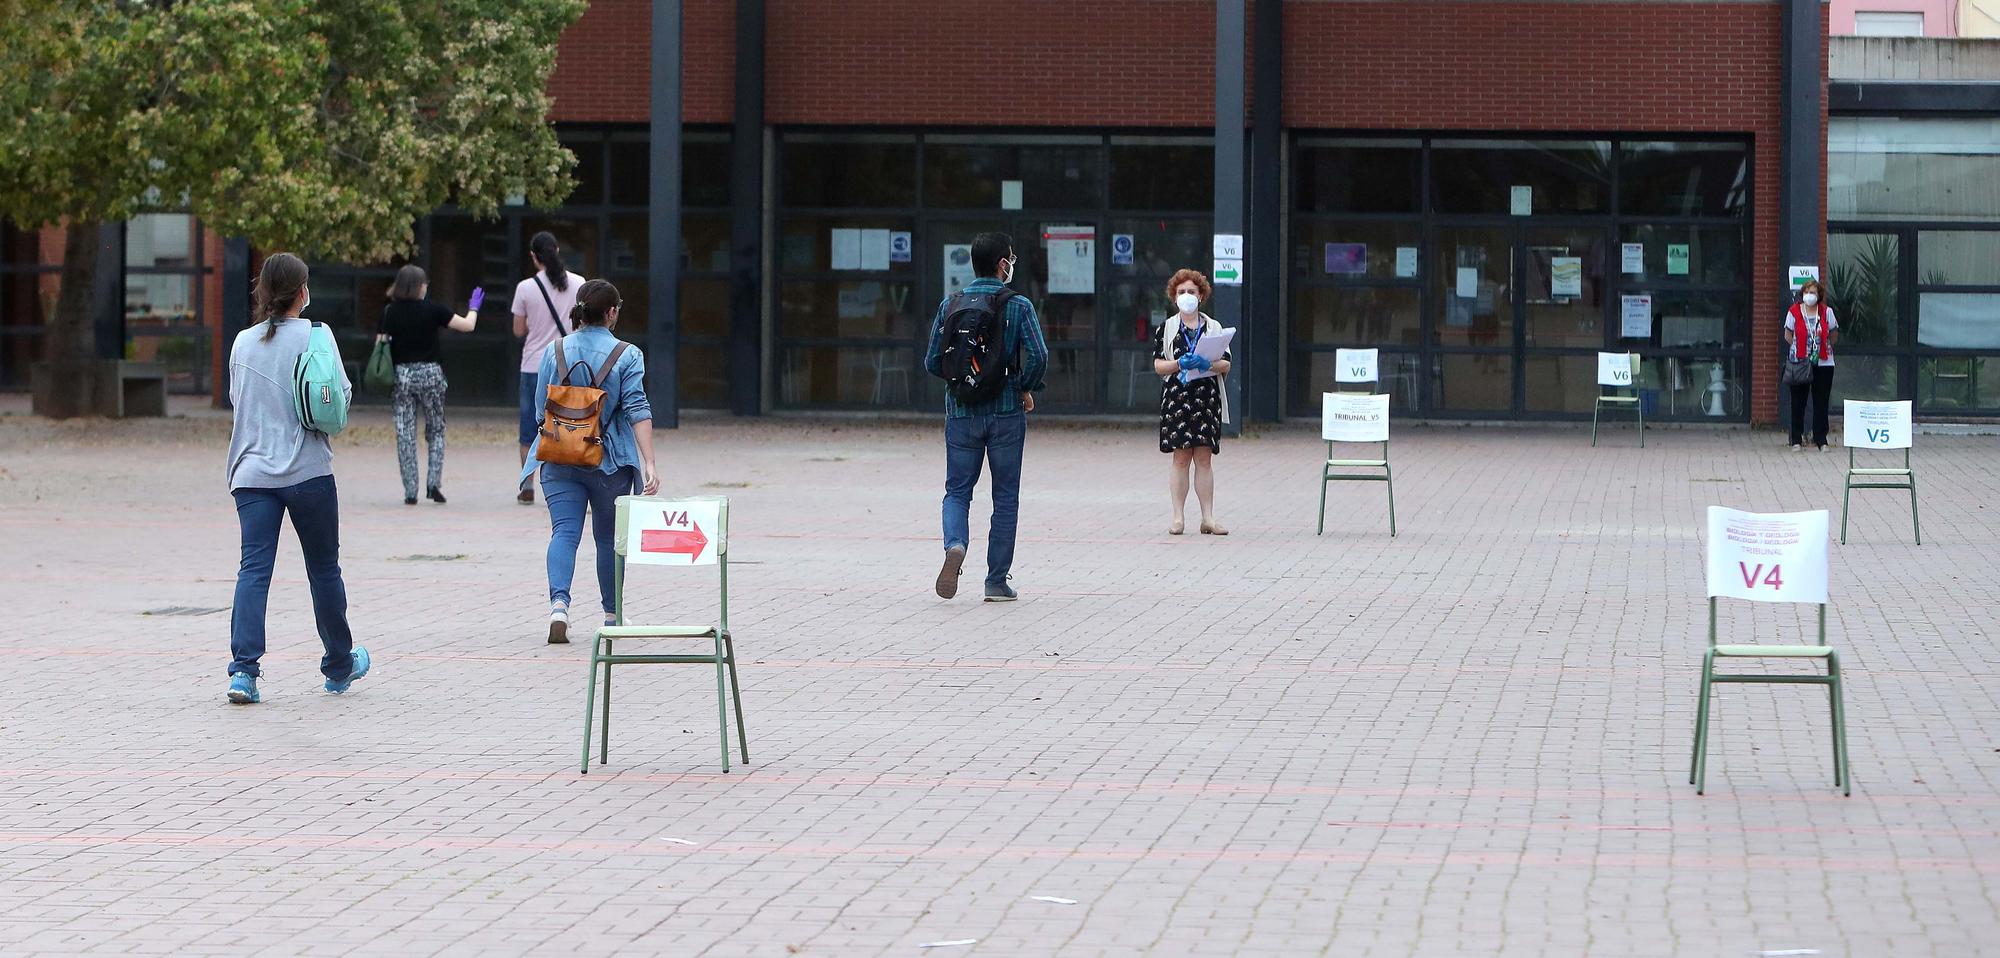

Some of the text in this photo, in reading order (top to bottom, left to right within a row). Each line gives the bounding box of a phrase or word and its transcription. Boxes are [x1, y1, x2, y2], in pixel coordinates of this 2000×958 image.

[1351, 367, 1367, 377] V6
[1613, 370, 1629, 381] V6
[1866, 428, 1890, 443] V5
[662, 510, 689, 527] V4
[1739, 561, 1784, 590] V4
